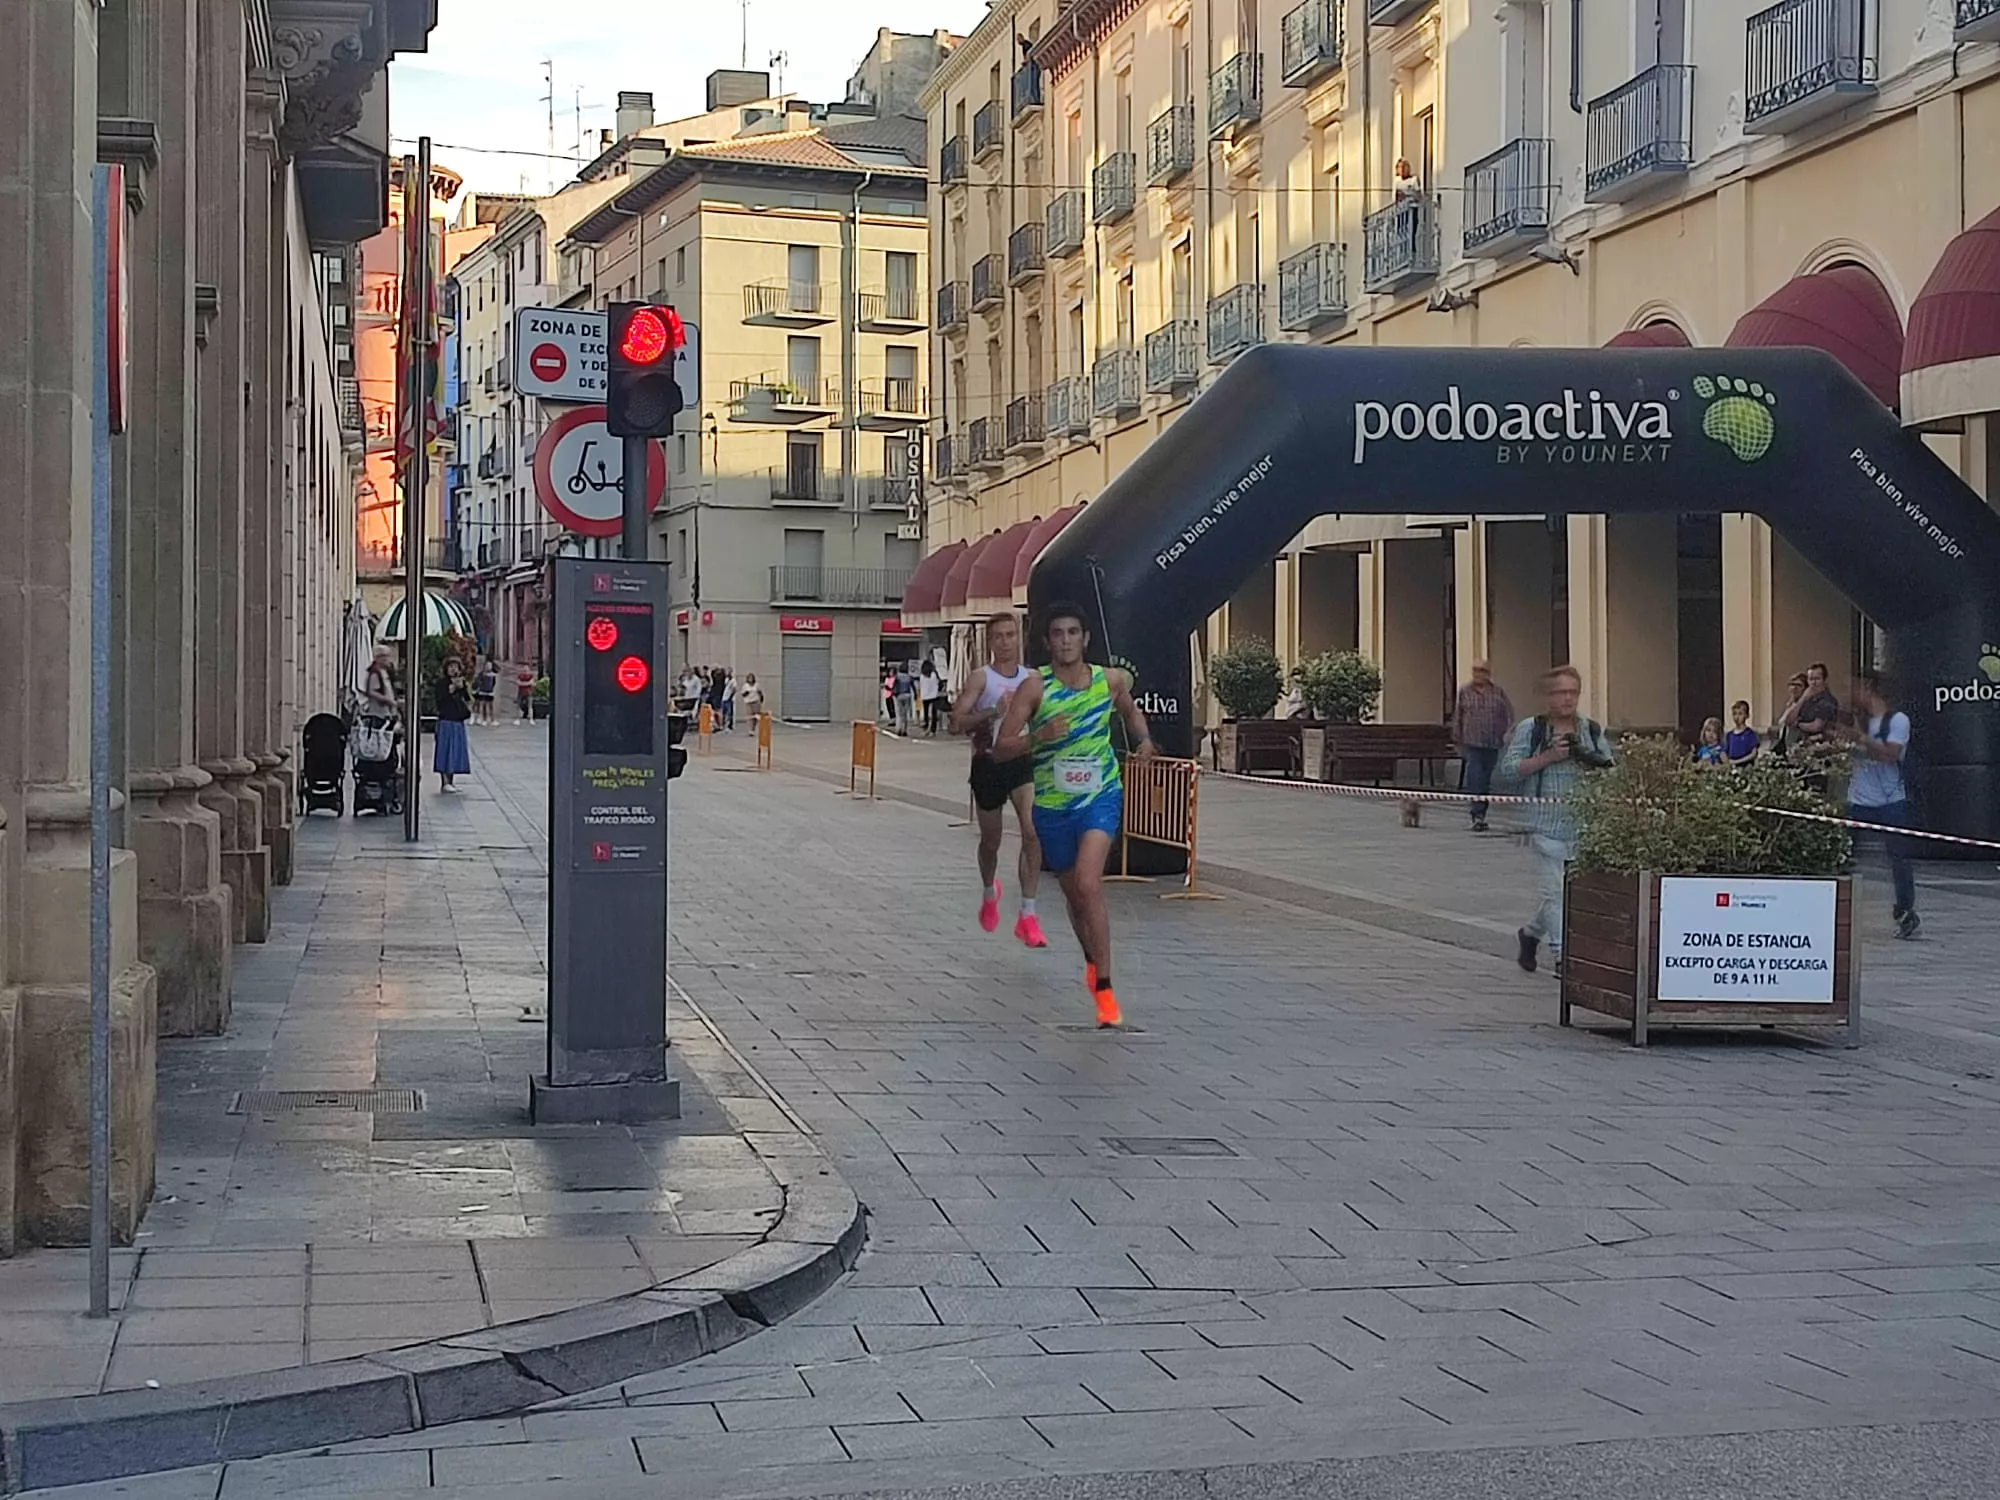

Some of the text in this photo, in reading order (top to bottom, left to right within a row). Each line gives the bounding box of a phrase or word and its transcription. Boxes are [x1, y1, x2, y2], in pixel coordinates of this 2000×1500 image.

[531, 319, 601, 338] ZONA DE
[580, 342, 608, 355] EXC
[580, 359, 608, 371] Y DE
[579, 378, 607, 390] DE 9
[1496, 443, 1672, 465] BY YOUNEXT
[907, 428, 920, 521] HOSTAL
[1849, 448, 1965, 560] Pisa bien, vive mejor
[1155, 454, 1274, 571] Pisa bien, vive mejor
[794, 619, 820, 630] GAES
[1134, 691, 1178, 714] ctiva
[590, 806, 648, 815] CONTROL DEL
[583, 816, 656, 825] TRAFICO RODADO
[1682, 932, 1811, 949] ZONA DE ESTANCIA
[1665, 956, 1828, 971] EXCEPTO CARGA Y DESCARGA
[1713, 972, 1729, 985] DE
[1731, 973, 1738, 985] 9
[1740, 973, 1750, 985] A
[1753, 973, 1764, 985] 11
